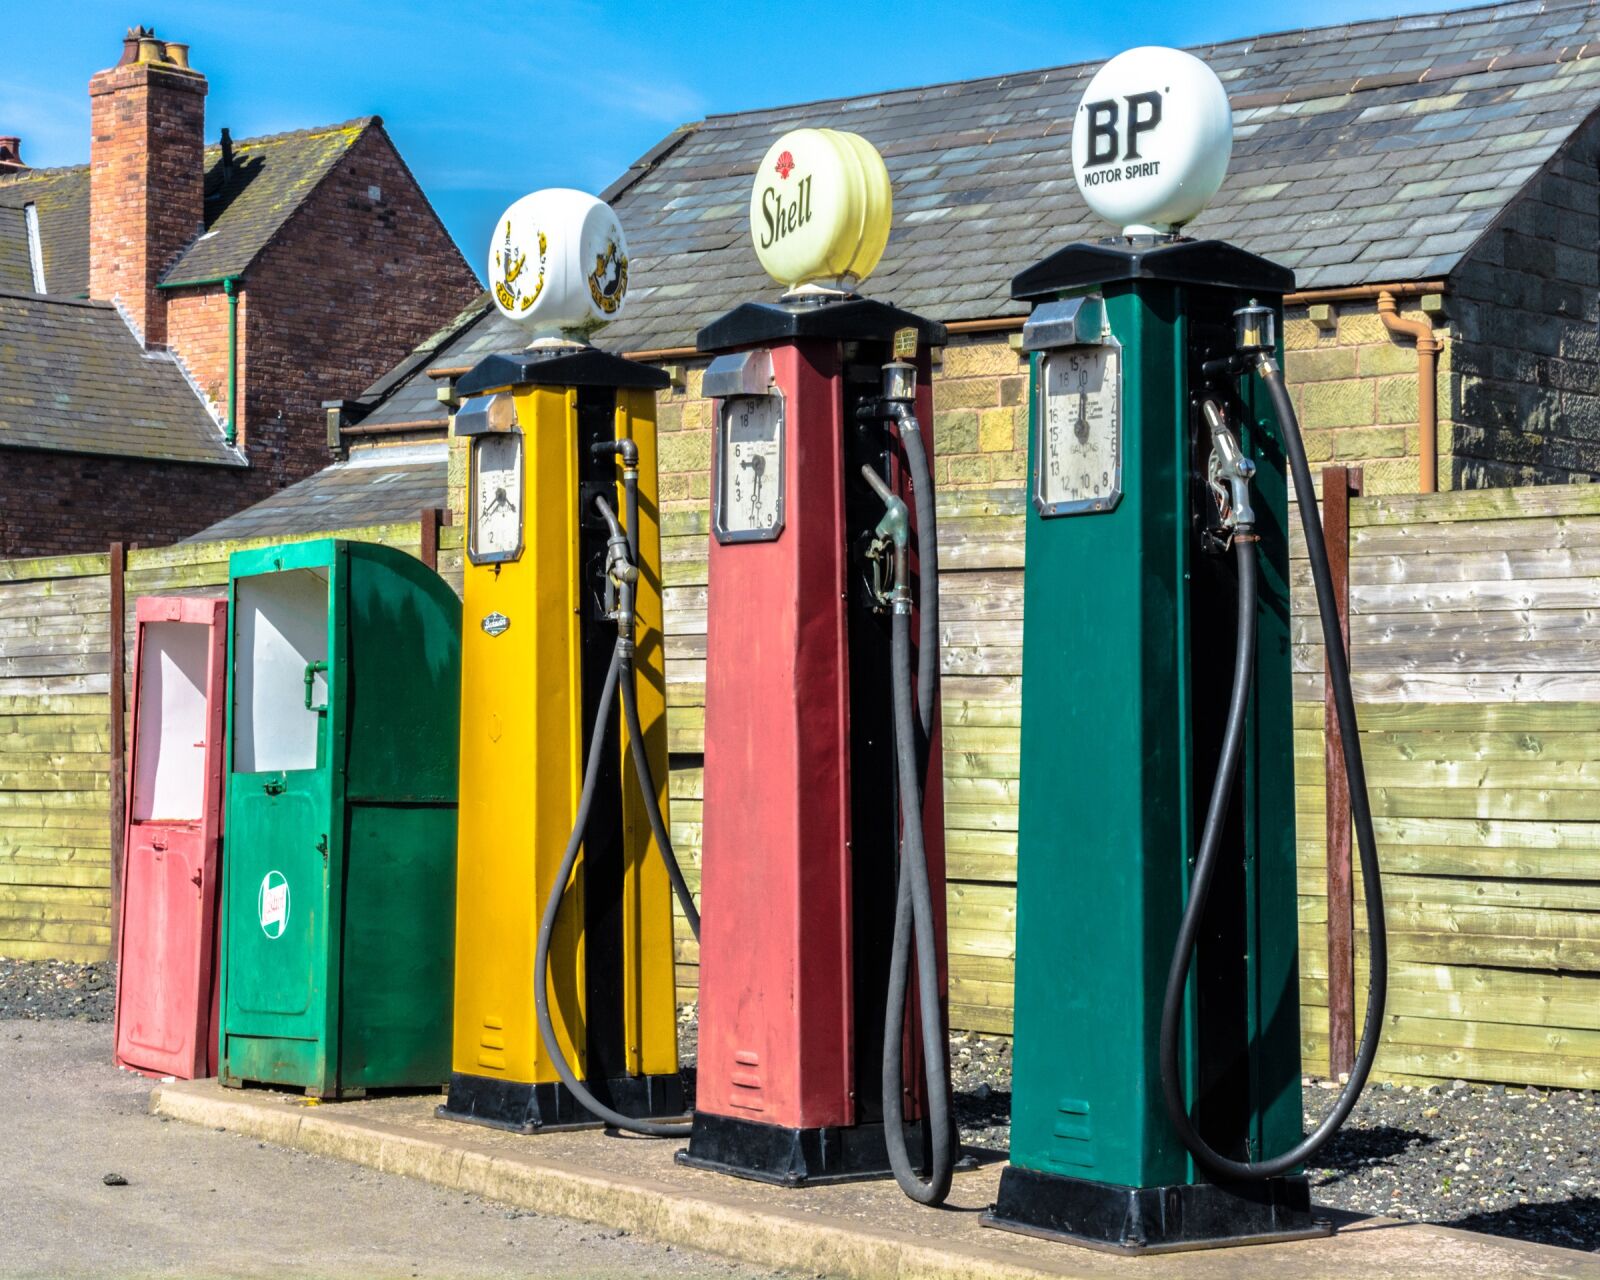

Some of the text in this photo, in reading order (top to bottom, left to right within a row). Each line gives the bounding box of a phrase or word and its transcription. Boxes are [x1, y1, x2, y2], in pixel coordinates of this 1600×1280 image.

[1084, 161, 1160, 187] MOTOR SPIRIT
[761, 174, 812, 249] Shell
[740, 414, 749, 428] 18
[735, 444, 741, 457] 6
[1102, 471, 1109, 487] 8
